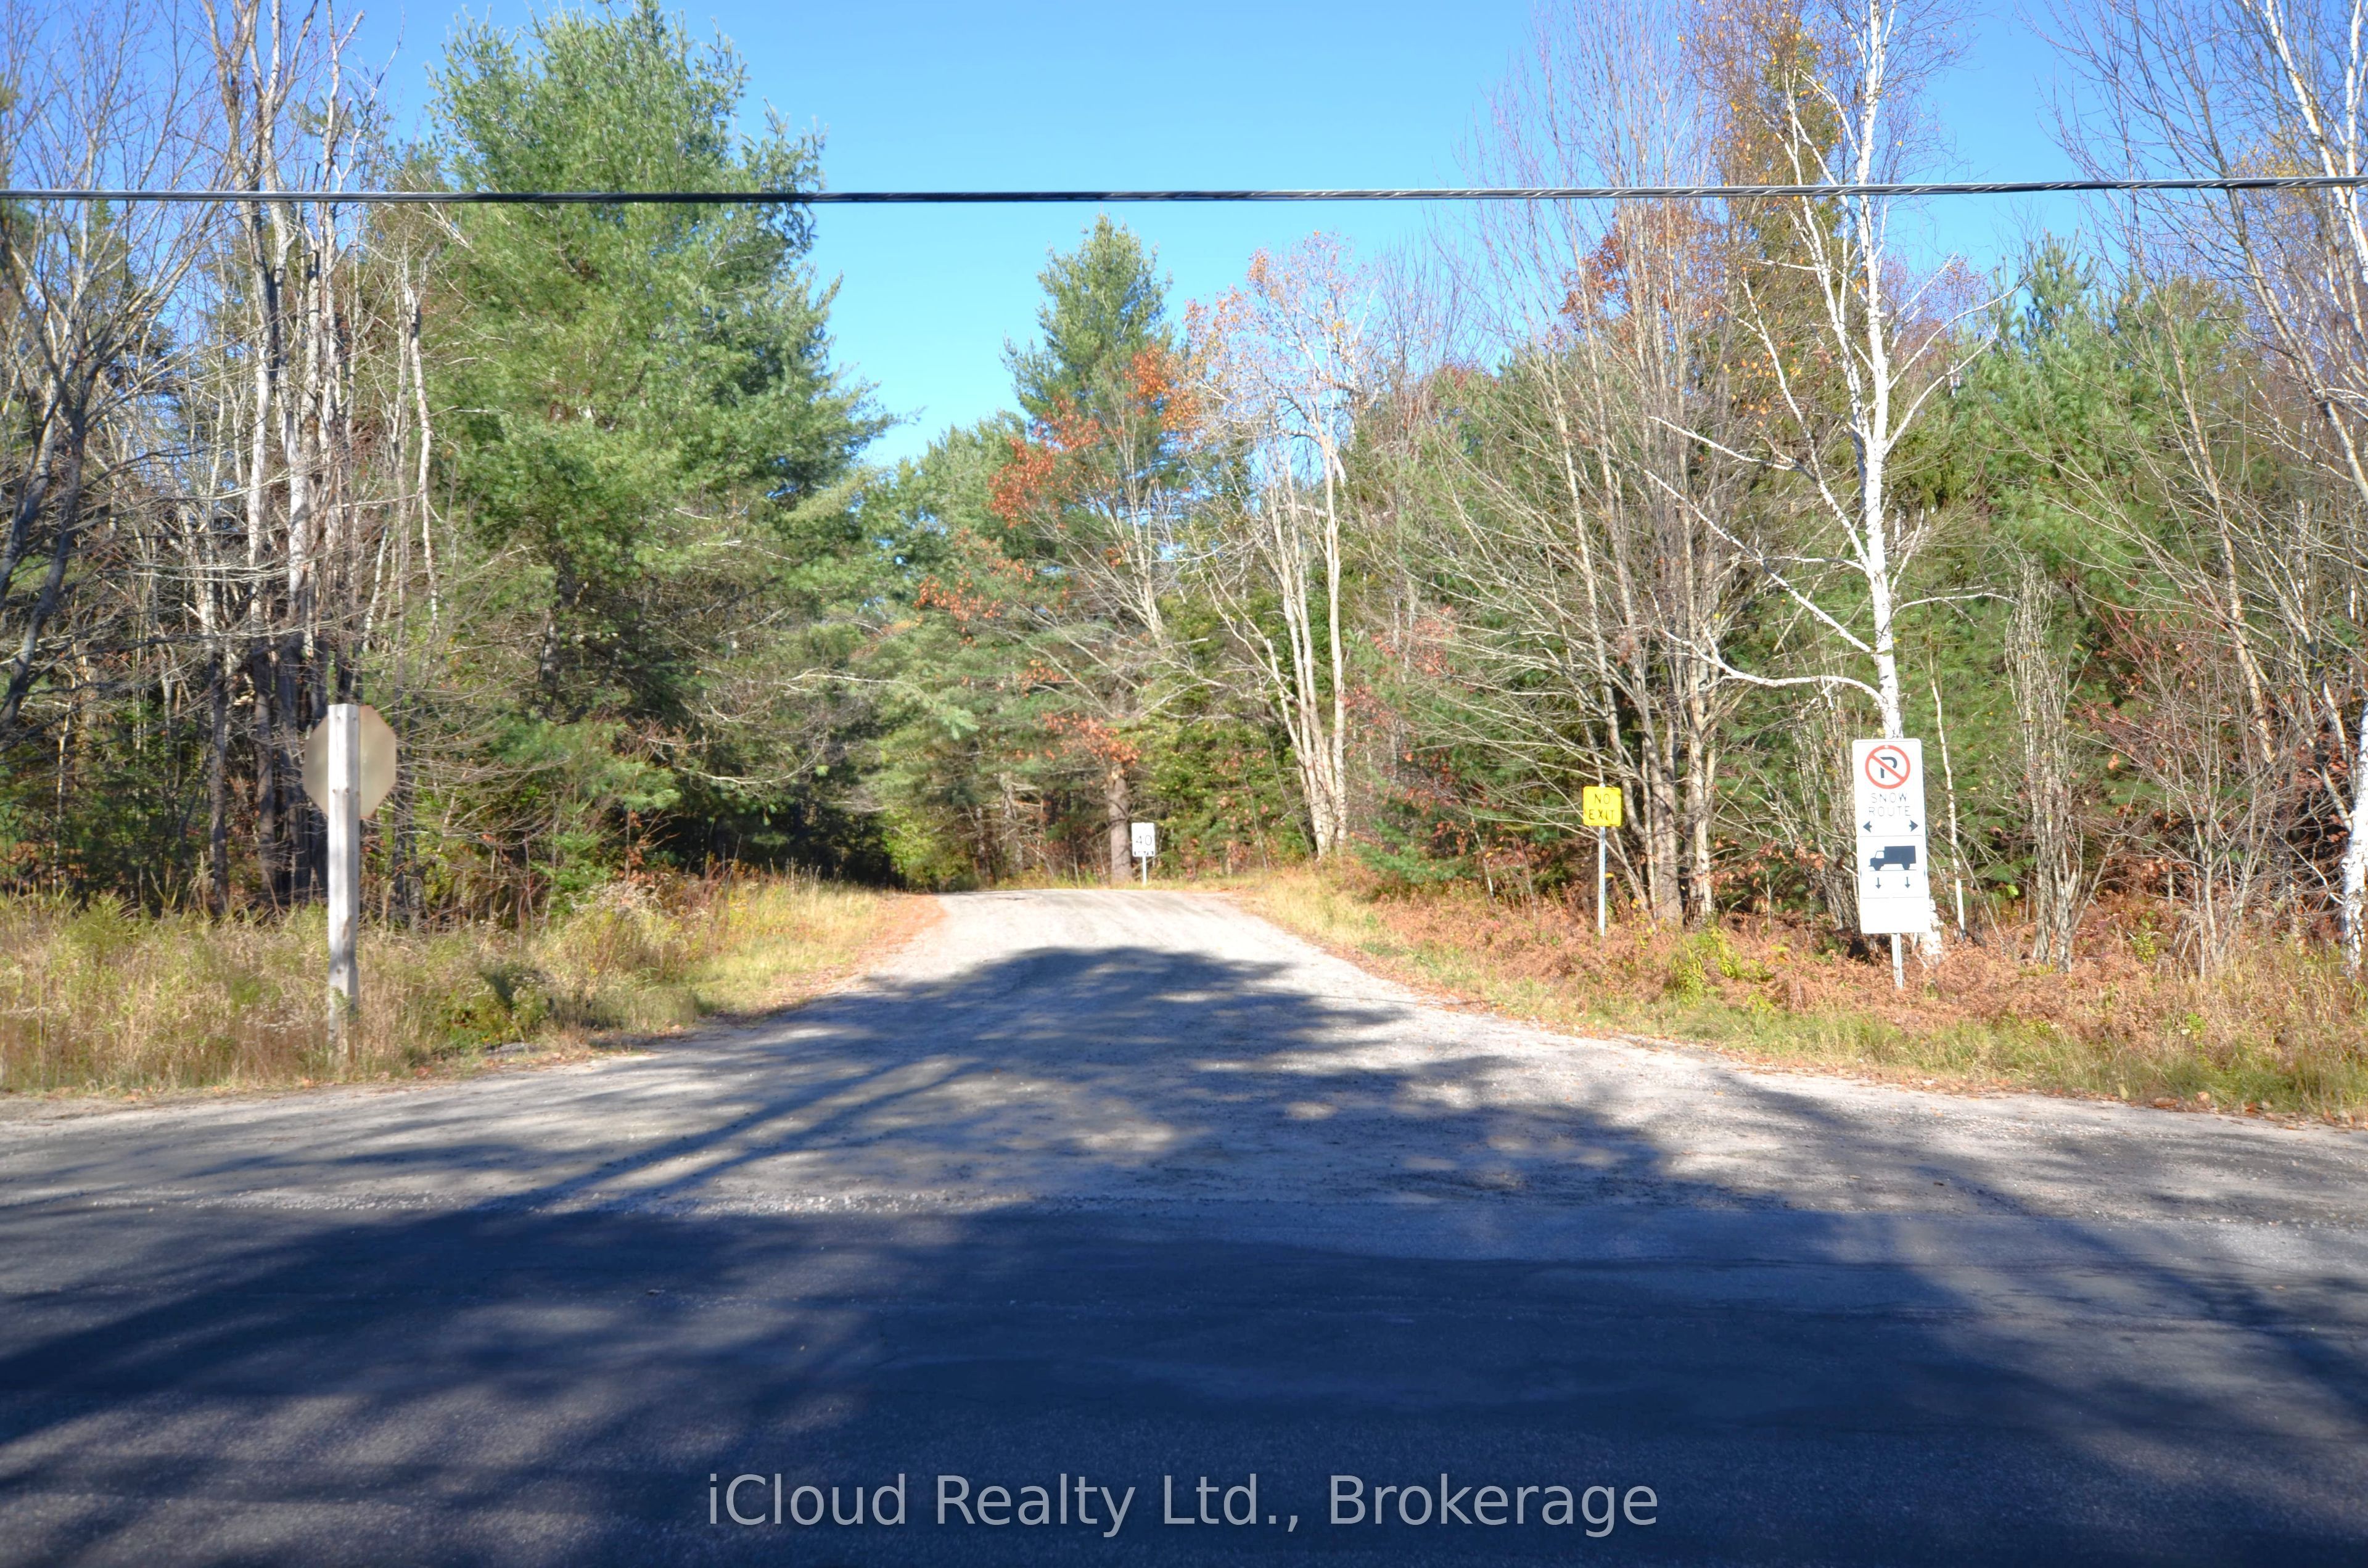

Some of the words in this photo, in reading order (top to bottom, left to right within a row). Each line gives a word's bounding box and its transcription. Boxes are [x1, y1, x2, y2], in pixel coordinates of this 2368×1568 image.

[1880, 757, 1897, 779] P
[1594, 793, 1610, 805] NO
[1870, 792, 1907, 803] SNOW
[1589, 809, 1614, 820] EXIT
[1868, 805, 1911, 817] ROUTE
[1135, 834, 1153, 846] 40
